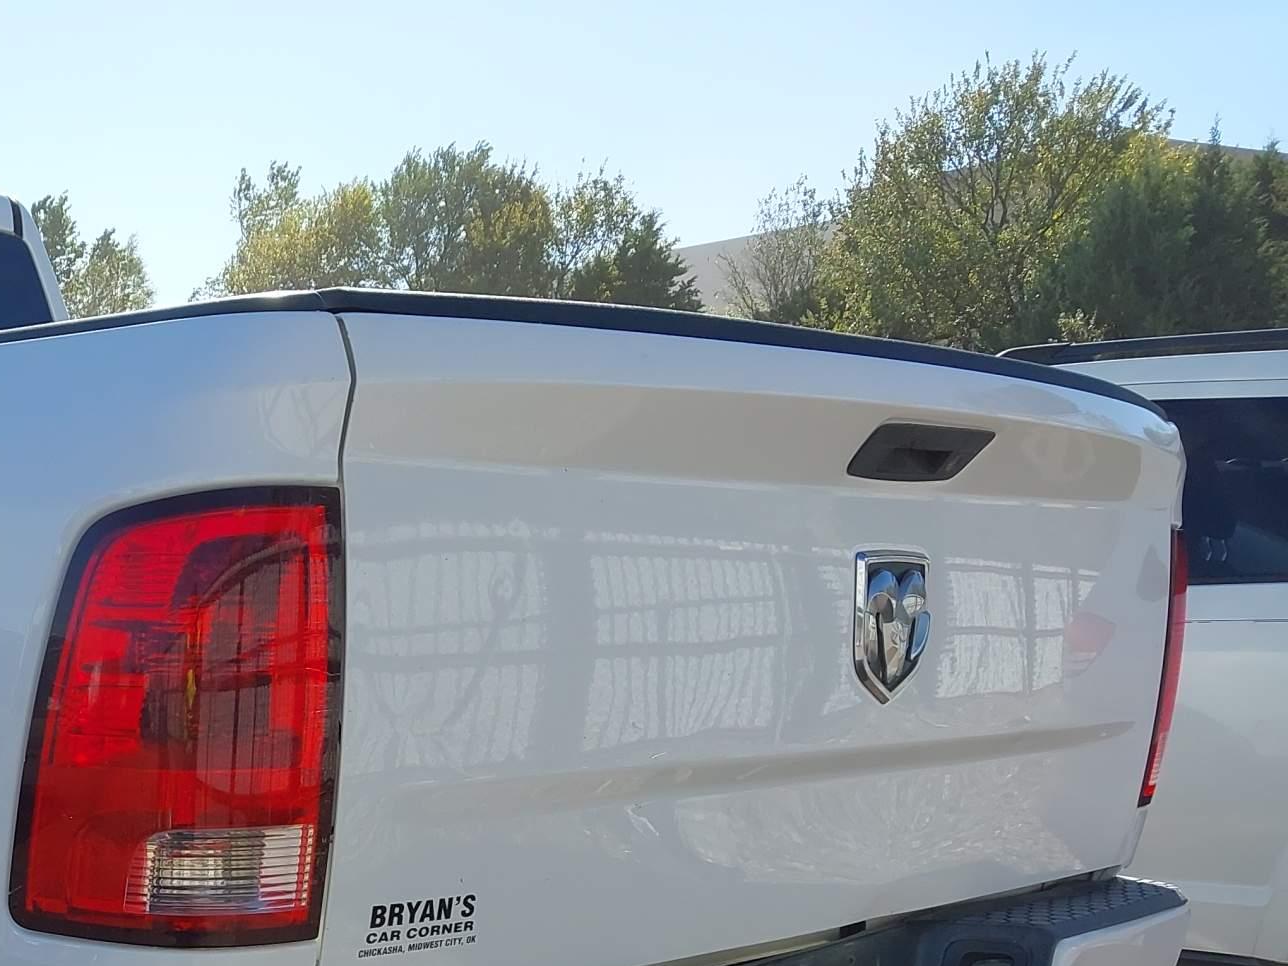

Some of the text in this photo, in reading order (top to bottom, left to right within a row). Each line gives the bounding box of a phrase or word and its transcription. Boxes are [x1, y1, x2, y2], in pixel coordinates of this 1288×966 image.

[369, 894, 477, 929] BRYAN'S
[366, 920, 474, 945] CAR CORNER
[358, 935, 477, 959] CHICKASHA, MIDWEST CITY, OK
